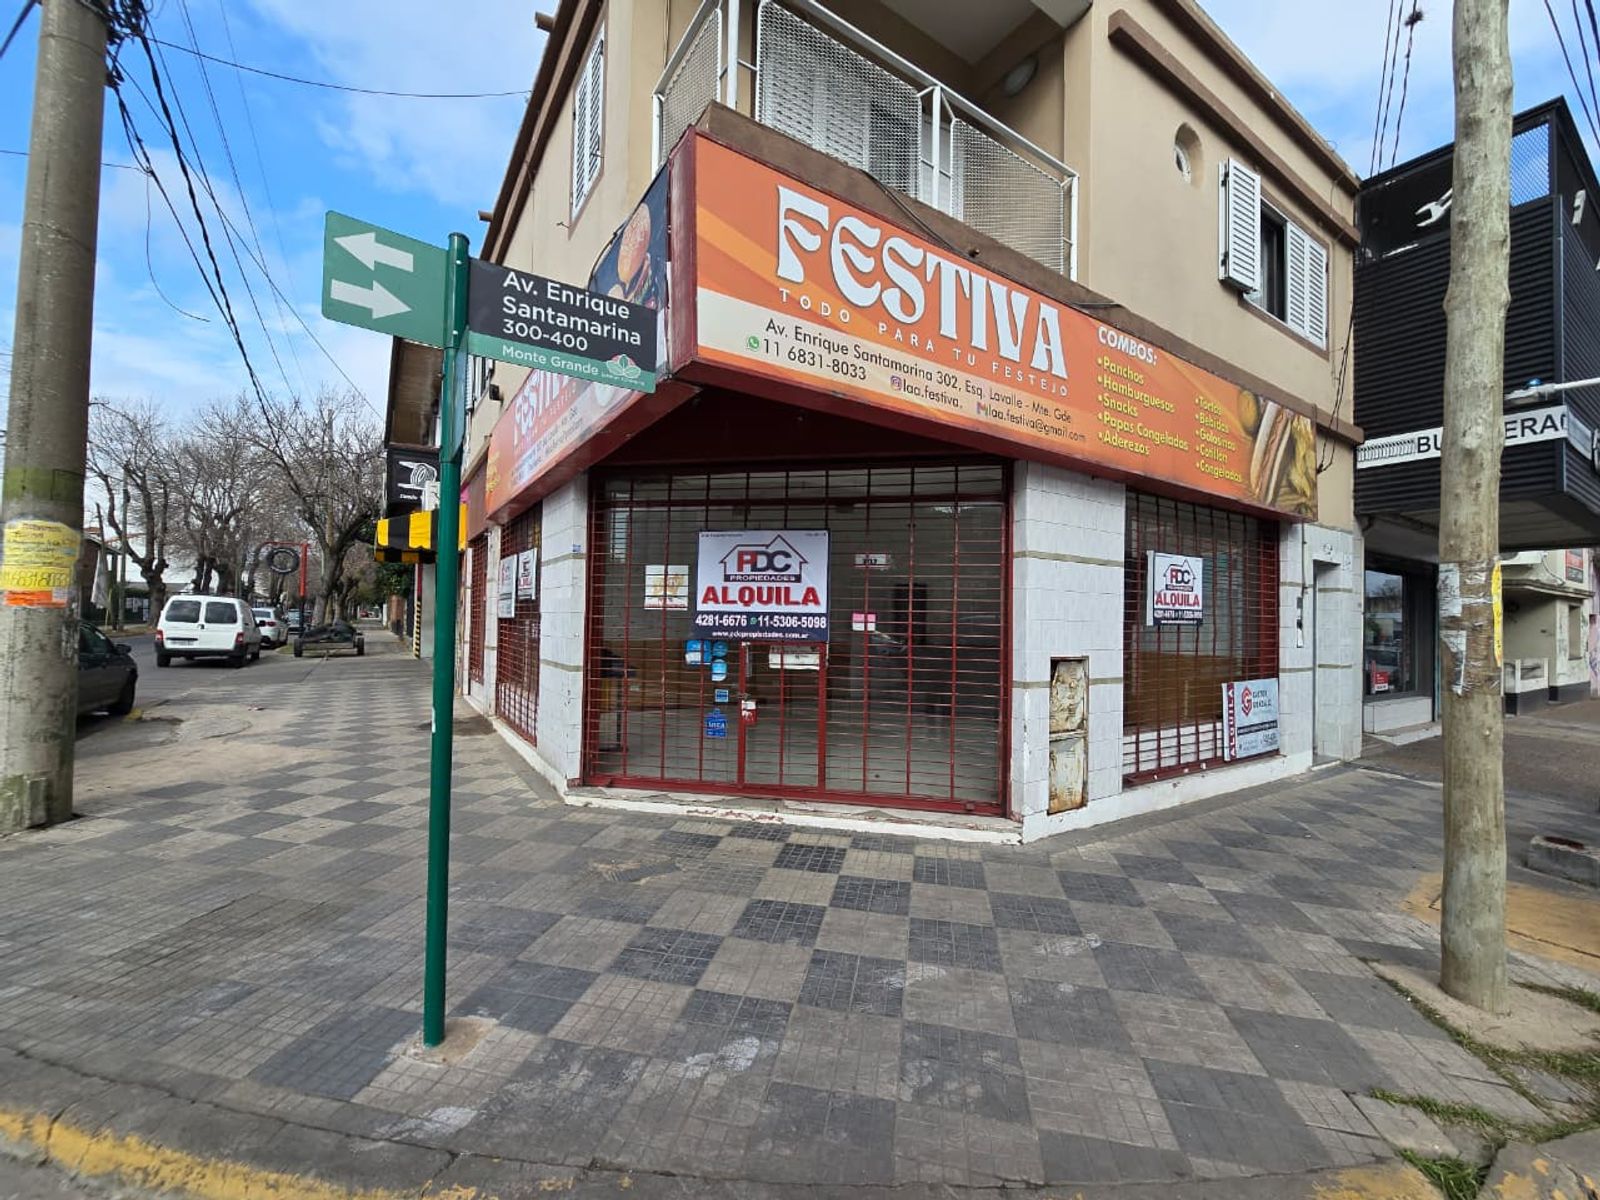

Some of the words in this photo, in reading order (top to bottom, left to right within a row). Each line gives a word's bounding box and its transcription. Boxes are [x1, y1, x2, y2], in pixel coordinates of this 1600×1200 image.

[503, 271, 538, 296] Av.
[547, 281, 630, 320] Enrique
[776, 185, 1069, 380] FESTIVA
[502, 296, 642, 346] Santamarina
[503, 319, 588, 352] 300-400
[764, 339, 780, 357] 11
[787, 346, 867, 380] 6831-8033
[779, 288, 850, 323] TODO
[878, 322, 935, 353] PARA
[952, 347, 976, 367] TU
[992, 362, 1069, 397] FESTEJO
[1098, 326, 1158, 366] COMBOS:
[502, 345, 547, 364] Monte
[550, 357, 599, 376] Grande
[765, 318, 788, 338] Av.
[795, 326, 849, 355] Enrique
[853, 344, 934, 381] Santamarina
[936, 370, 962, 392] 302,
[990, 388, 1024, 409] Lavalle
[1103, 356, 1145, 385] Panchos
[1103, 376, 1176, 413] Hamburguesas
[1103, 393, 1139, 418] Snacks
[1103, 412, 1135, 433] Papas
[1137, 422, 1189, 451] Congelados
[1103, 430, 1150, 456] Aderezos
[729, 574, 796, 582] PROPIEDADES
[701, 585, 821, 607] ALQUILA
[1155, 592, 1200, 607] ALQUILA
[695, 614, 747, 626] 4281-6676
[758, 616, 827, 629] 11-5306-5098
